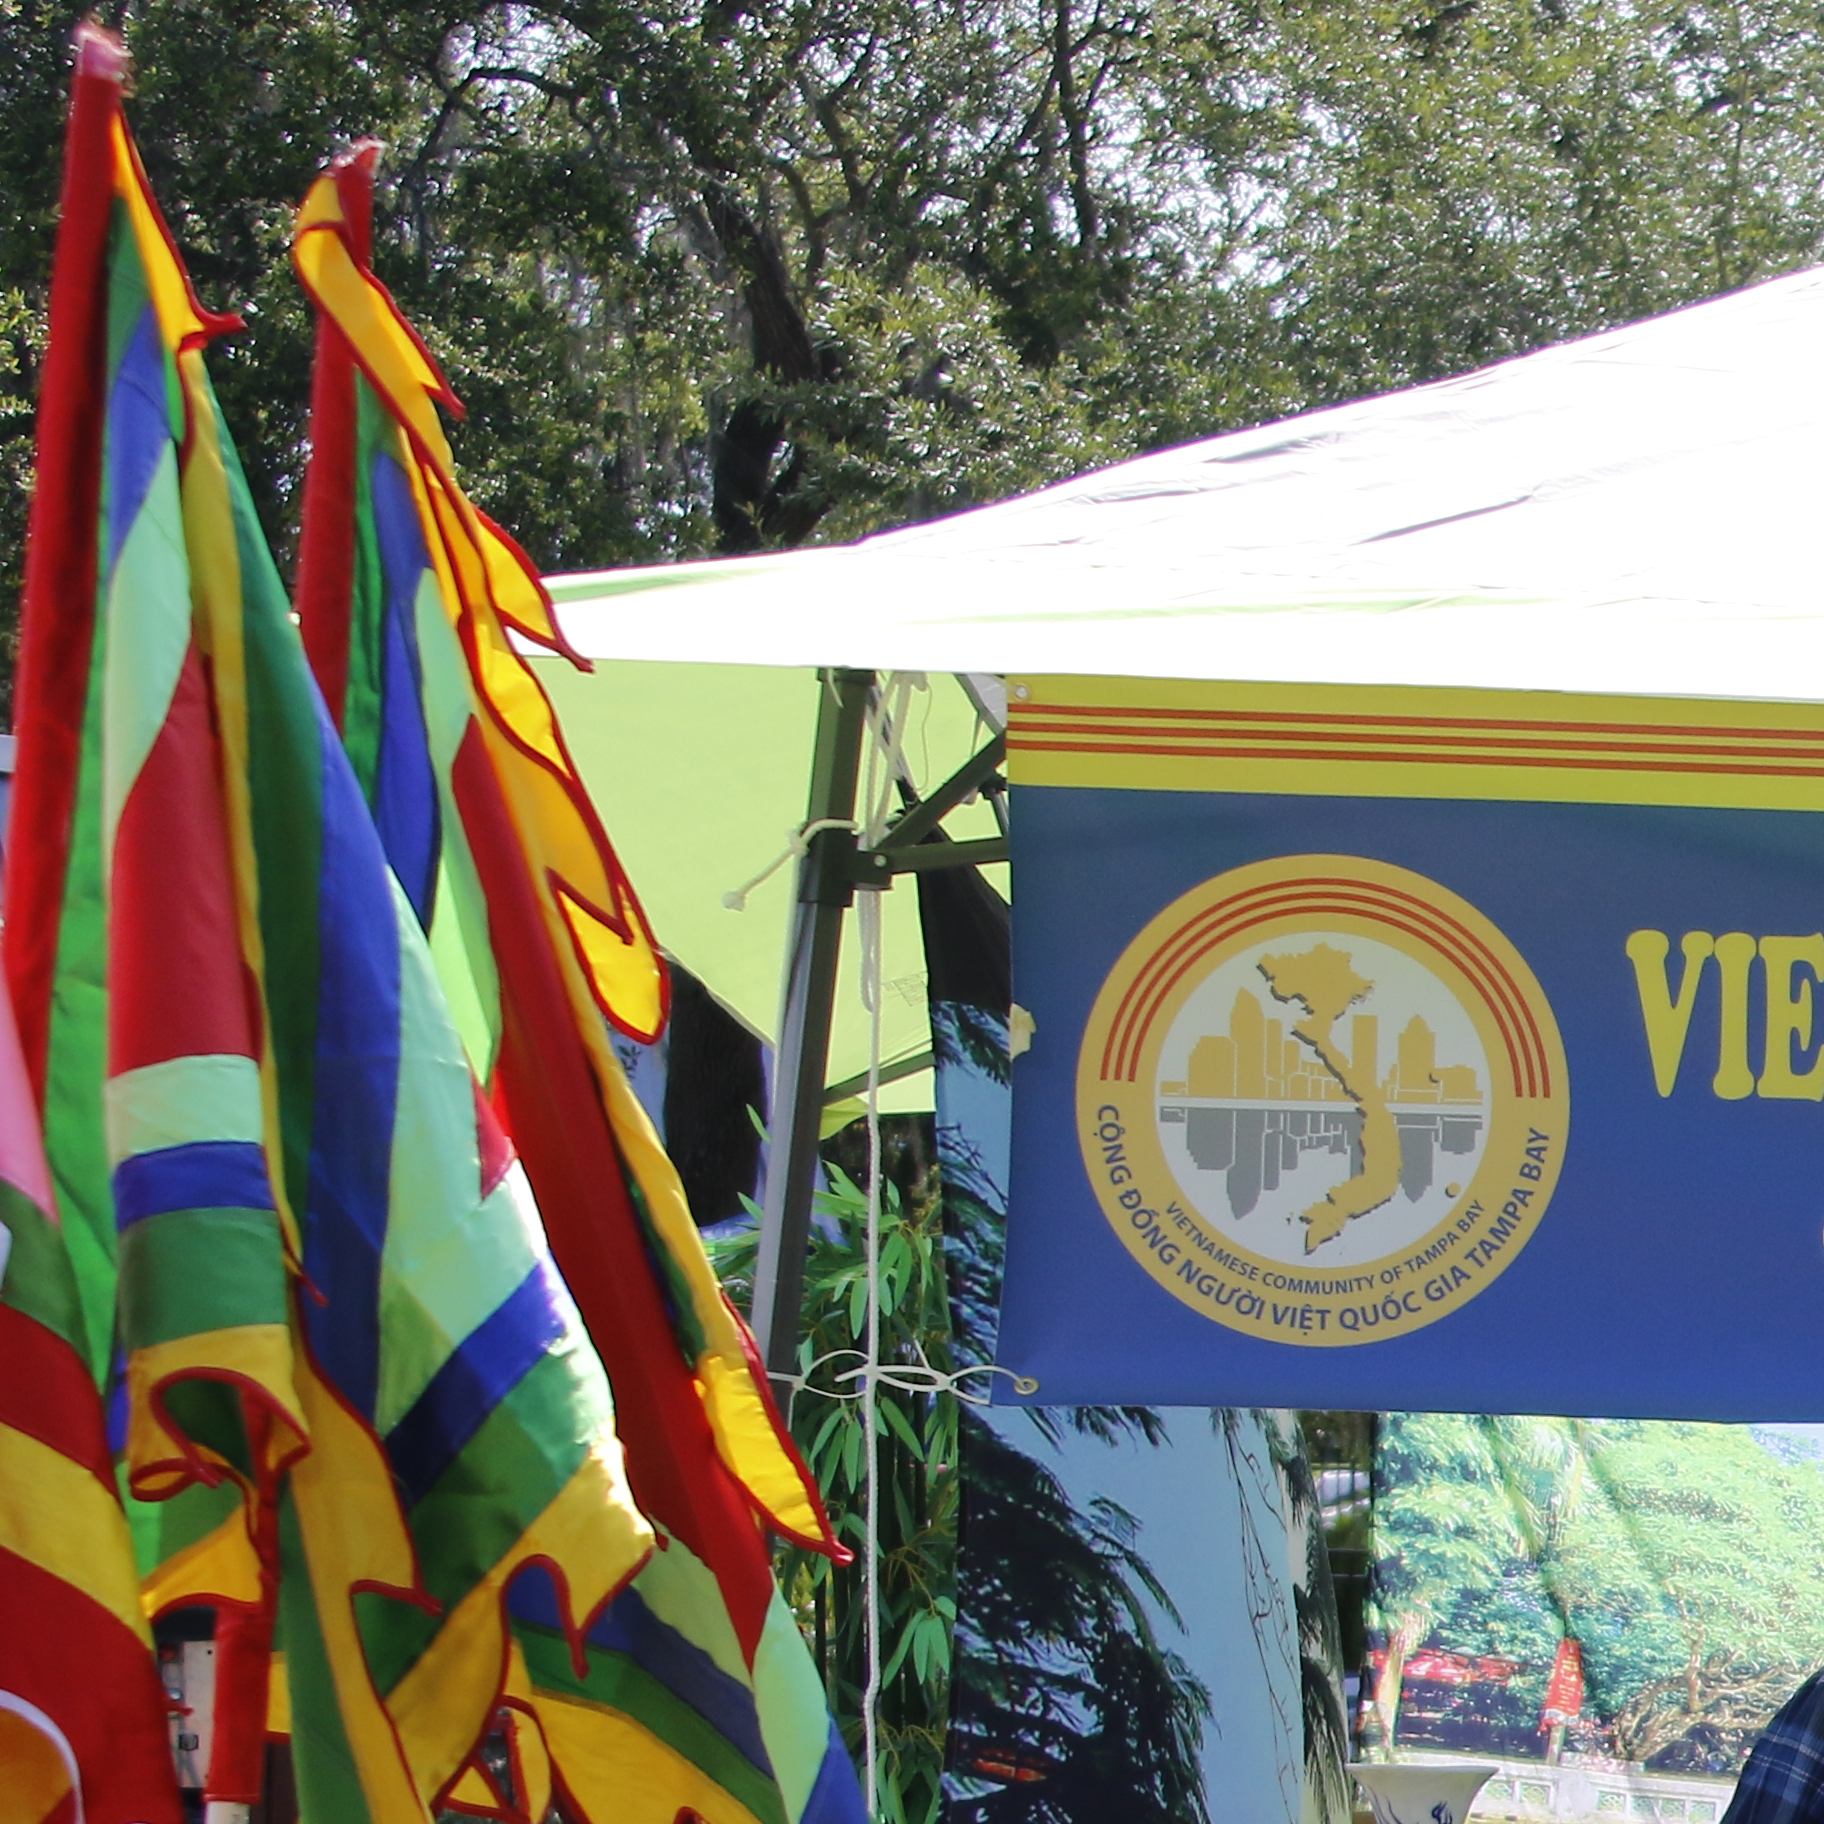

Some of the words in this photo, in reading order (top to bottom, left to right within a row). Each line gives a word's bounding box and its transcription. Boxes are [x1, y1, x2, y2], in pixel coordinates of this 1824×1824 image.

[1093, 1104, 1132, 1186] CỘNG
[1271, 1301, 1332, 1336] VIỆT
[1338, 1286, 1422, 1332] QUỐC
[1424, 1264, 1471, 1302] GIA
[1466, 1187, 1536, 1269] TAMPA
[1519, 1128, 1551, 1183] BAY
[1166, 1201, 1260, 1281] VIETNAMESE
[1262, 1273, 1376, 1296] COMMUNITY
[1379, 1264, 1404, 1285] OF
[1401, 1233, 1460, 1276] TAMPA
[1455, 1199, 1488, 1237] BAY
